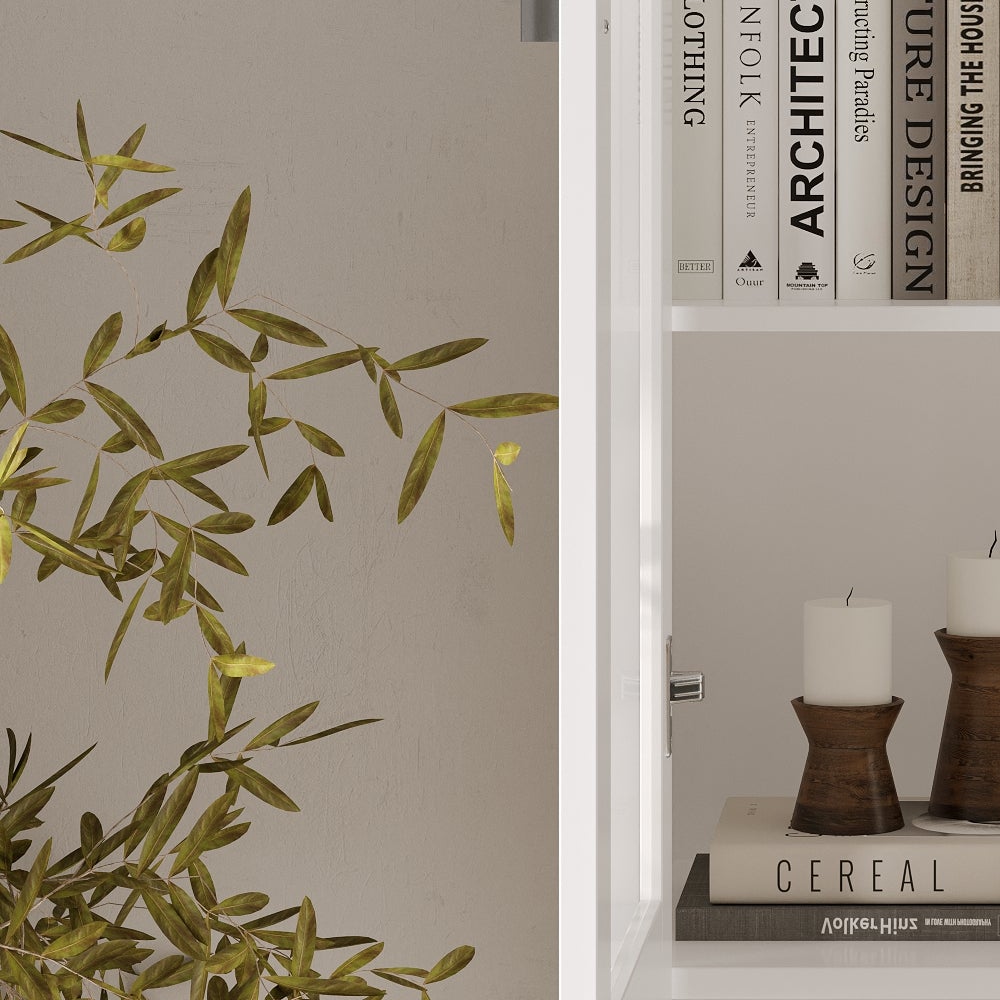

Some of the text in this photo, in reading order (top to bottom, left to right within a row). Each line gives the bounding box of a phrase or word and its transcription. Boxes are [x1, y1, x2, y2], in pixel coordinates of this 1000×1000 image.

[854, 68, 876, 143] Paradies
[960, 60, 984, 97] THE
[746, 120, 756, 218] ENTREPRENEUR
[960, 103, 984, 193] BRINGING
[905, 118, 934, 295] DESIGN
[679, 262, 711, 271] BETTER
[776, 859, 945, 893] CEREAL
